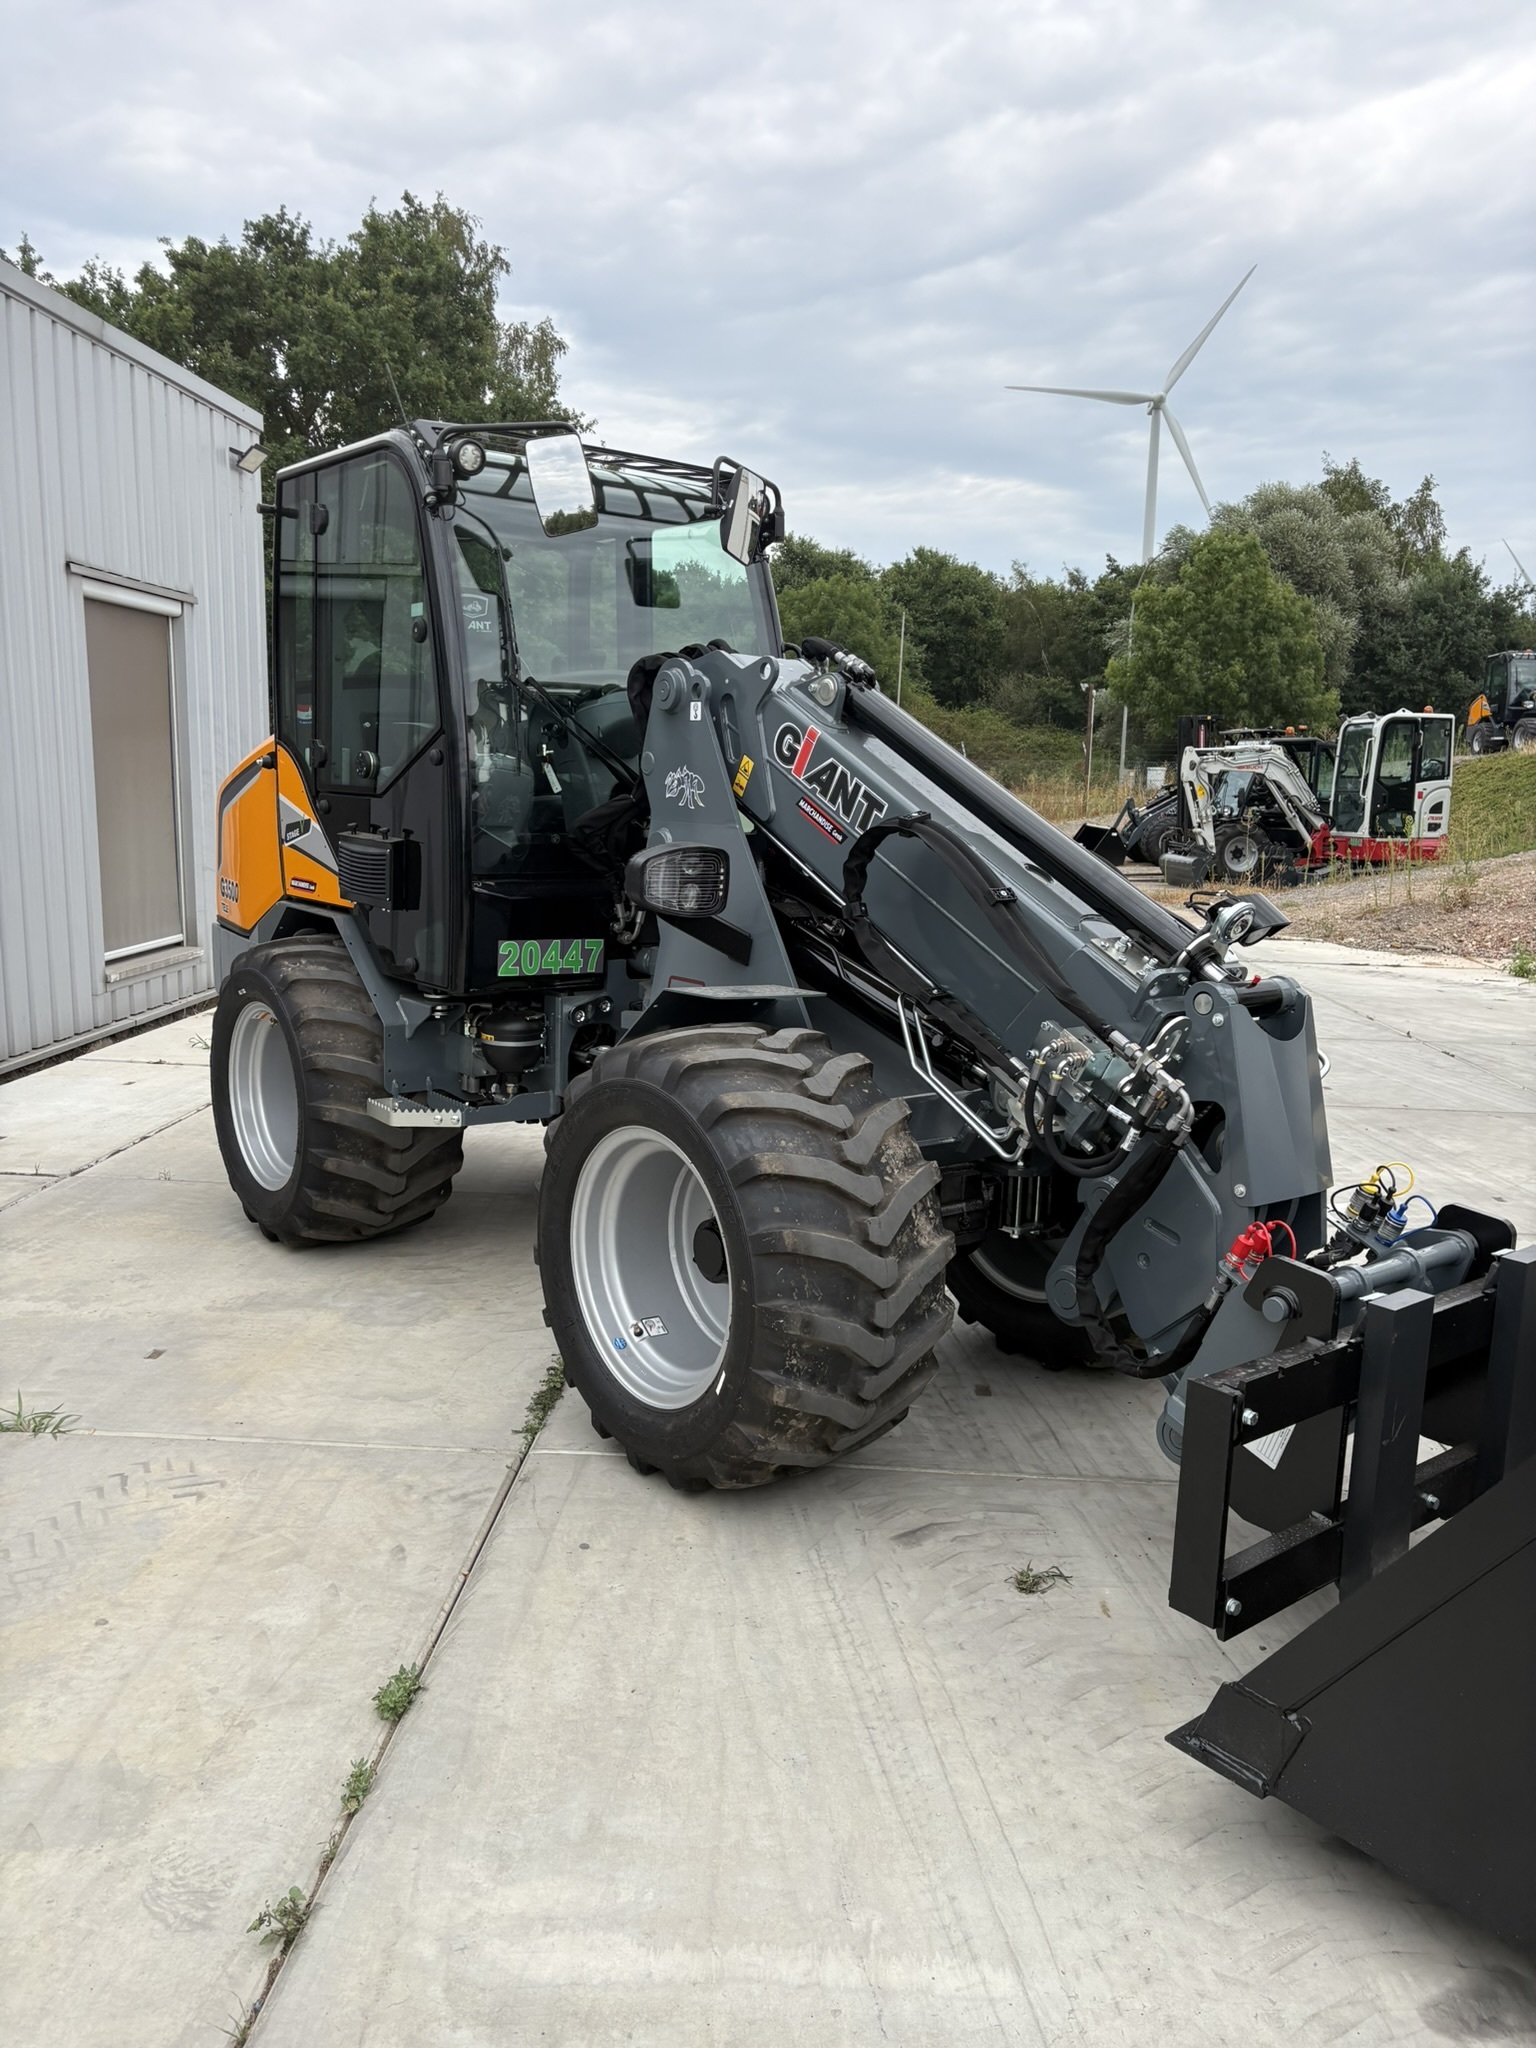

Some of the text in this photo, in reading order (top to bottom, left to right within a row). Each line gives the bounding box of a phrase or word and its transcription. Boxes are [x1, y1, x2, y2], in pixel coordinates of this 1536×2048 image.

[468, 620, 492, 630] ANT
[773, 721, 889, 835] GIANT
[286, 827, 300, 841] STAGE
[798, 799, 843, 841] MARCHANDISE Genk
[498, 939, 604, 976] 20447
